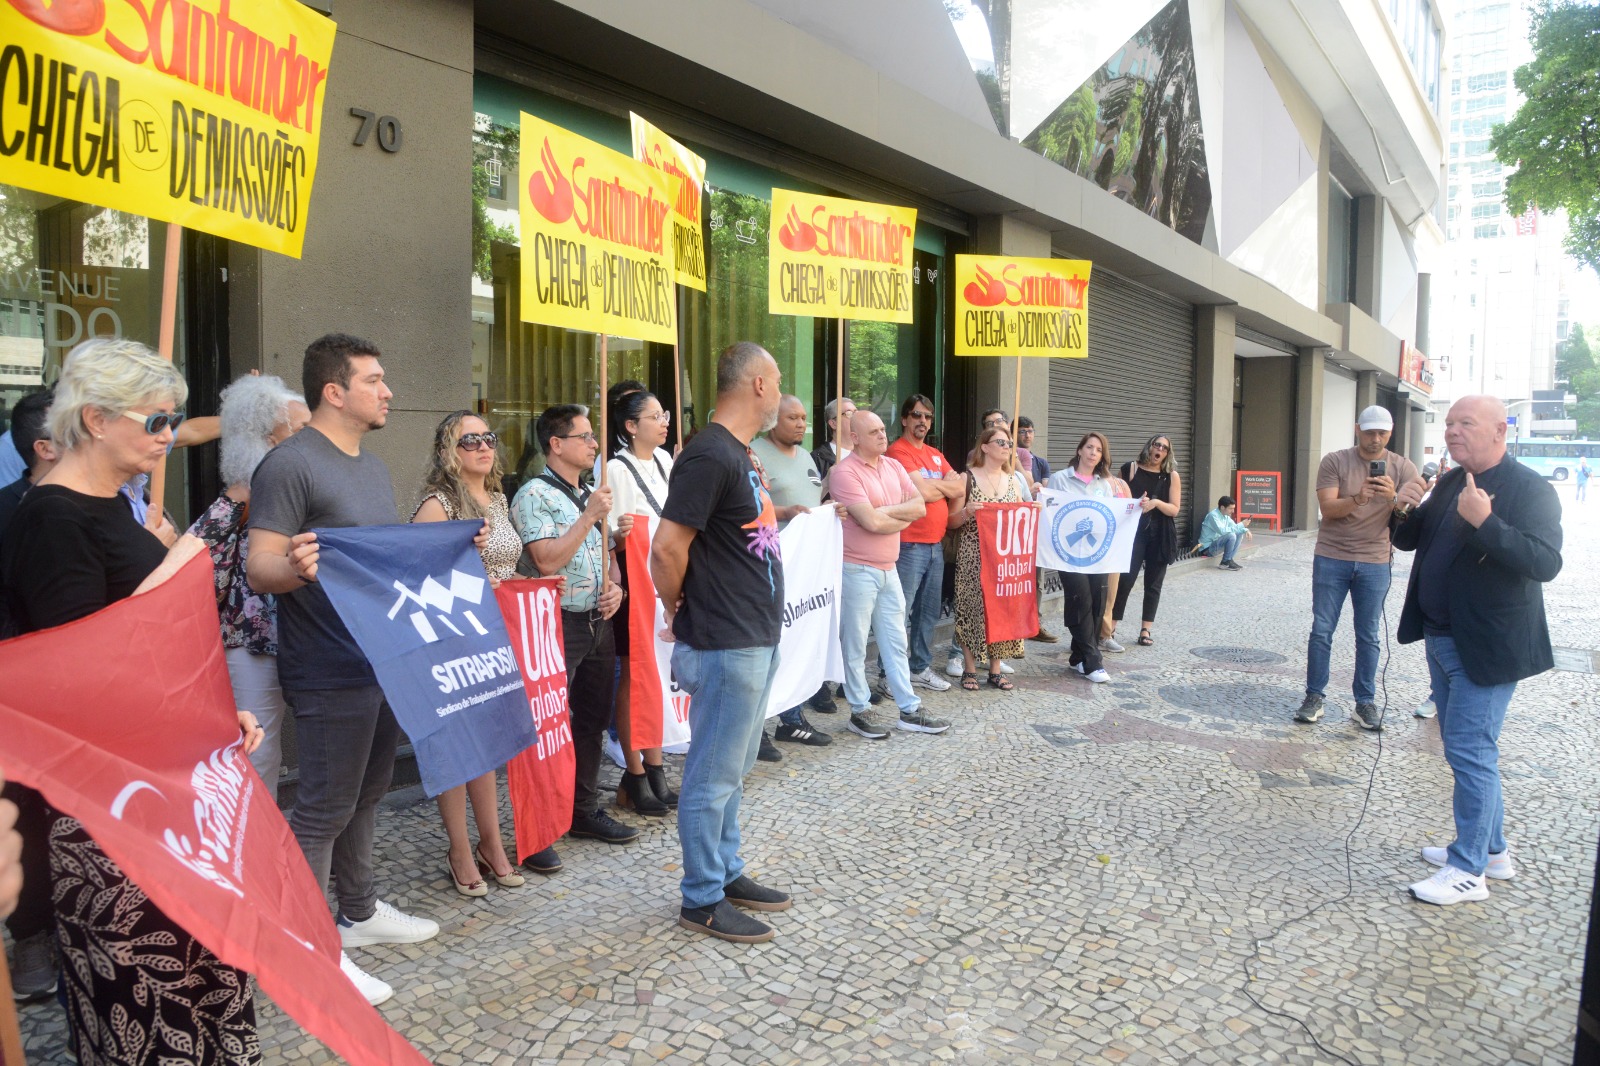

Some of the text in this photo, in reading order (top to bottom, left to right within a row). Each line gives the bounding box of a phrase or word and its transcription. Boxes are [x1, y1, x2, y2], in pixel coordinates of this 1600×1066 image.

[0, 45, 306, 233] CHEGA DE DEMISSÕES
[350, 107, 401, 153] 70
[572, 157, 671, 256] Santander
[811, 205, 911, 266] Santander
[535, 232, 590, 311] CHEGA
[603, 250, 672, 328] DEMISSÕES
[780, 262, 826, 305] CHEGA
[840, 267, 909, 312] DEMISSÕES
[965, 310, 1008, 348] CHEGA
[1017, 309, 1082, 349] DEMISSÕES
[995, 506, 1037, 557] UNI
[996, 577, 1032, 597] union
[997, 556, 1032, 582] global
